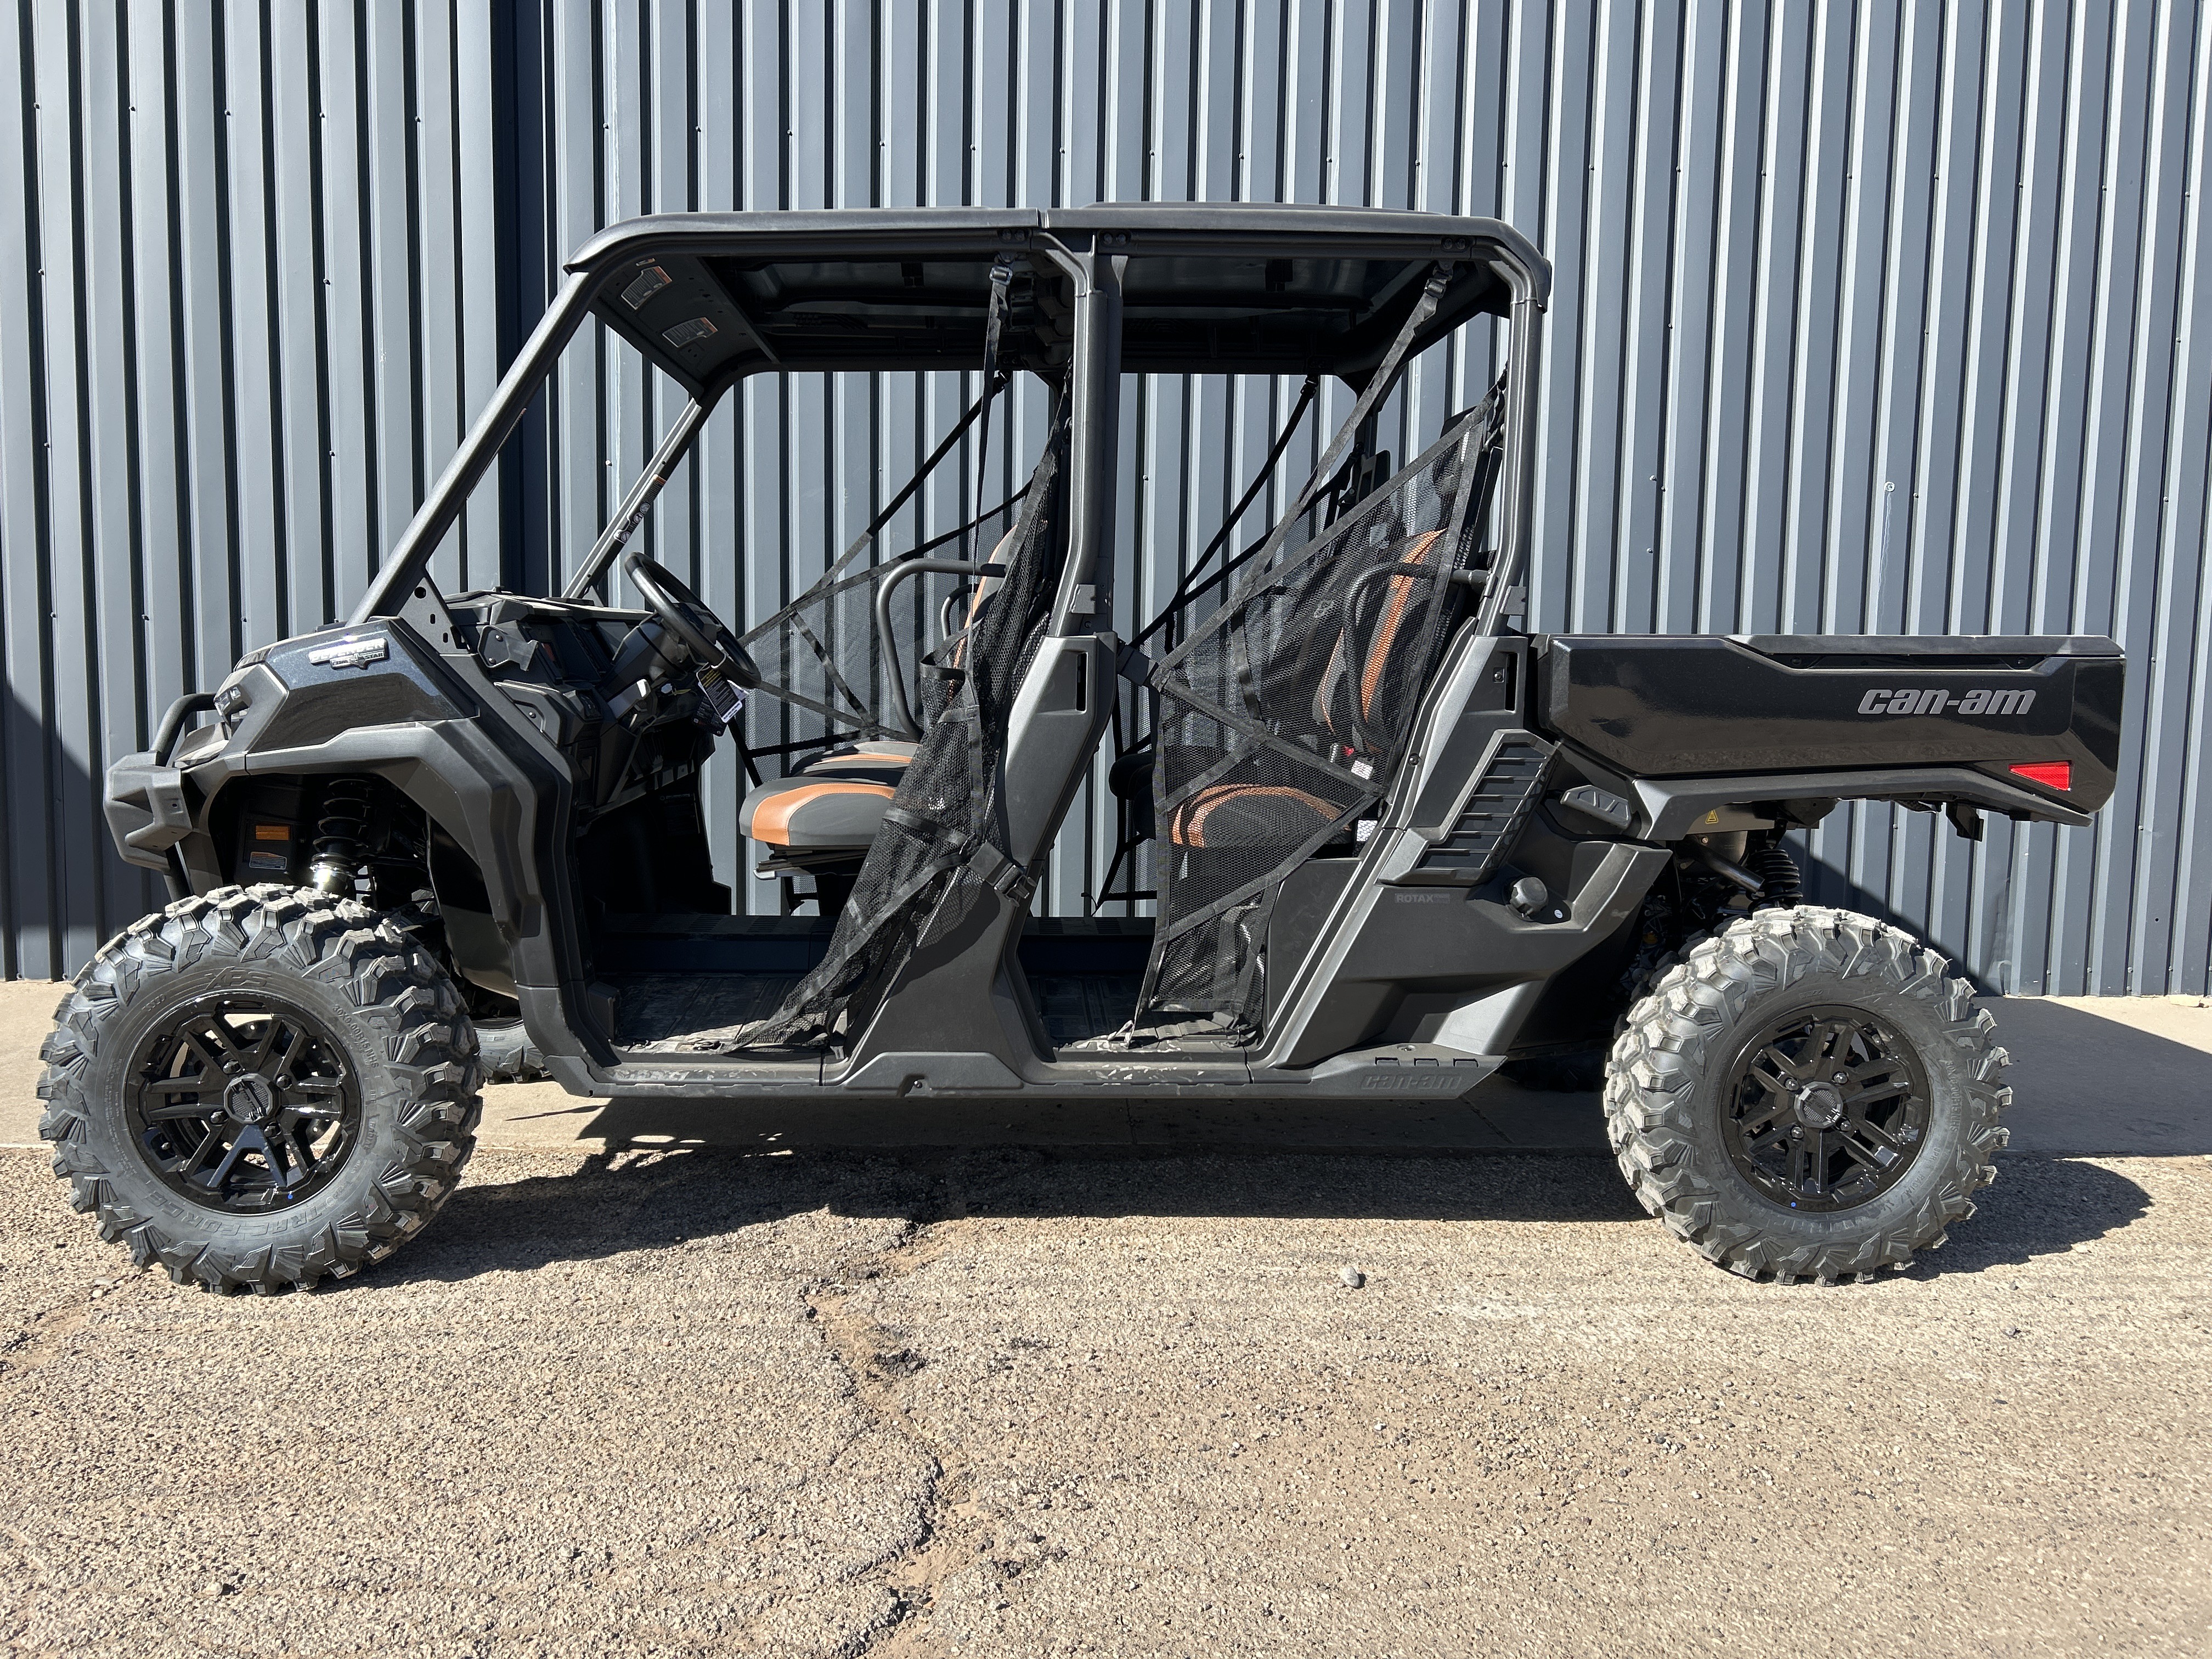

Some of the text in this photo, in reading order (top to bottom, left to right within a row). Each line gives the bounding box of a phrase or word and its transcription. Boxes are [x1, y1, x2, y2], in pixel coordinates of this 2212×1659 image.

[1858, 689, 2036, 714] can-am
[1396, 894, 1434, 902] ROTAX
[1361, 1074, 1462, 1090] can-am
